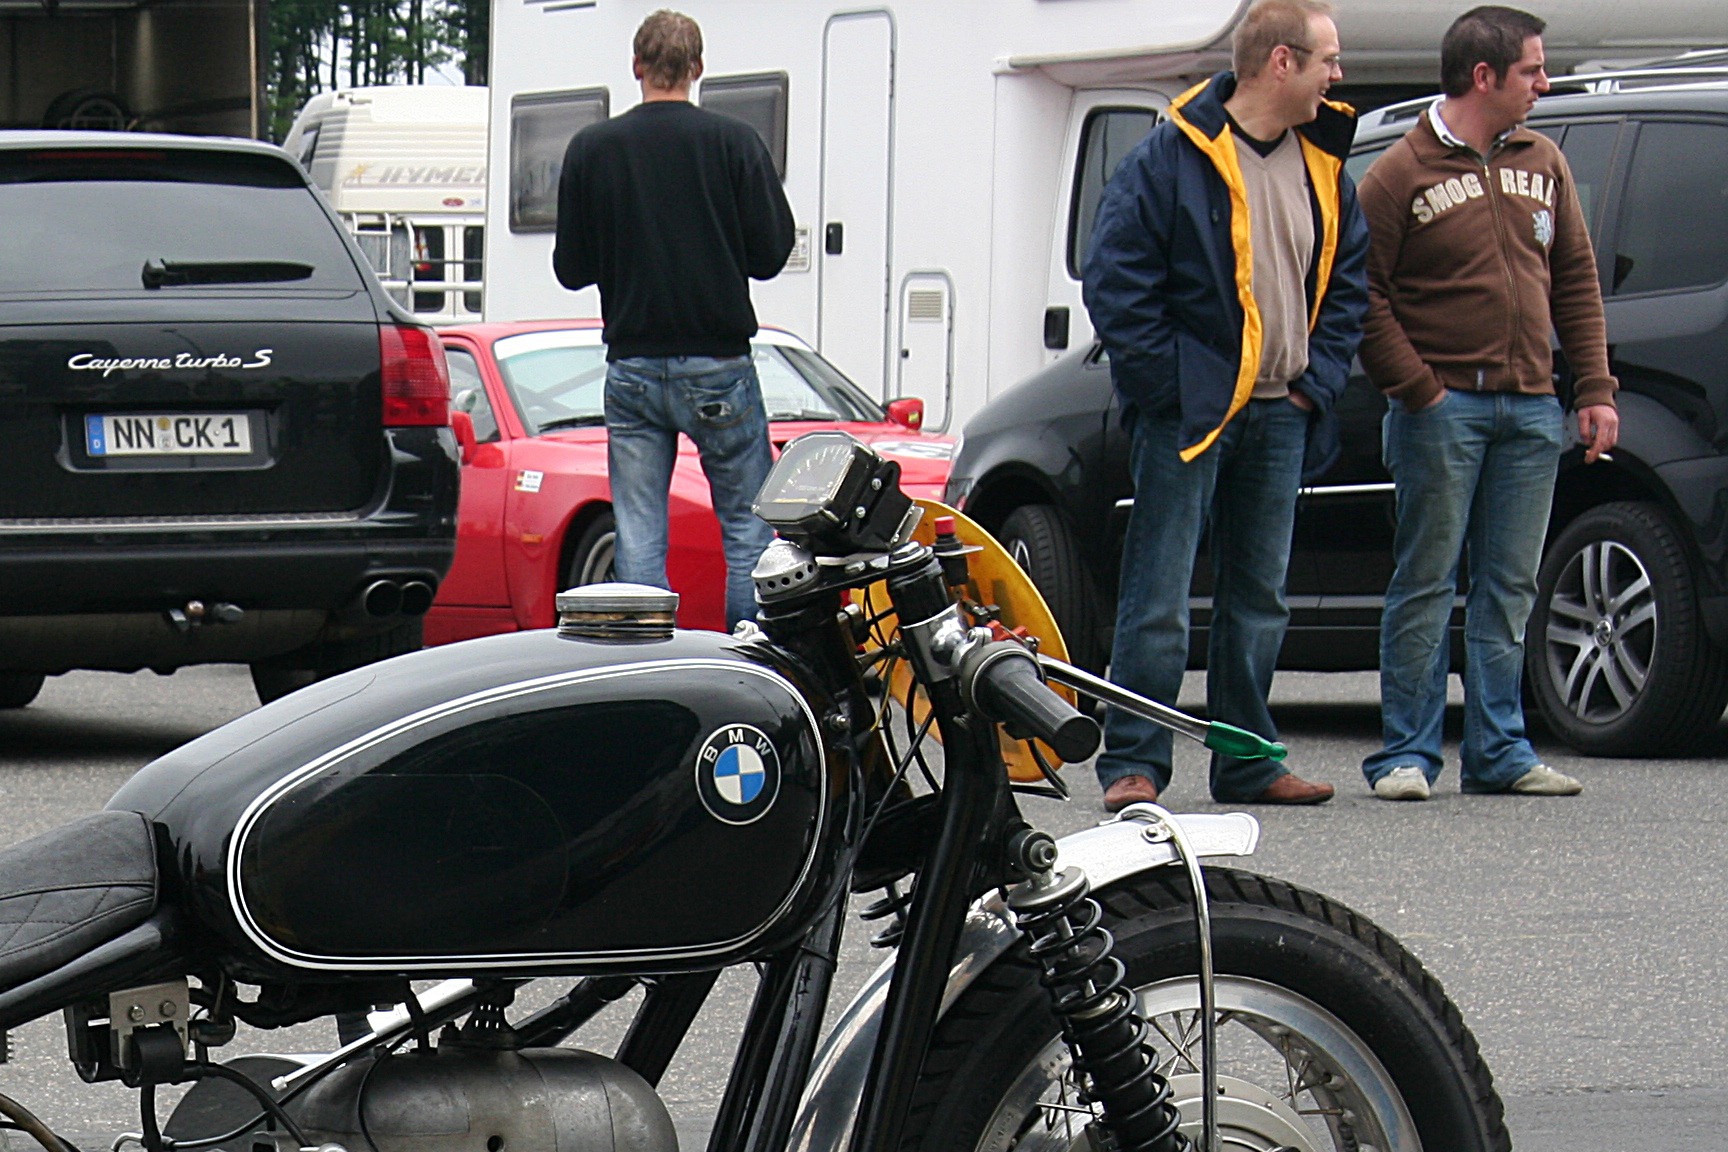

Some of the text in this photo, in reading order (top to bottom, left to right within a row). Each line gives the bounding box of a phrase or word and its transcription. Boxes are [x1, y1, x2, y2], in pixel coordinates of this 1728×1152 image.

[1412, 167, 1554, 224] SMOG REAL
[67, 349, 273, 378] Cayenne turbo S
[113, 418, 155, 449] NN
[174, 417, 215, 448] CK
[703, 728, 771, 763] BMW
